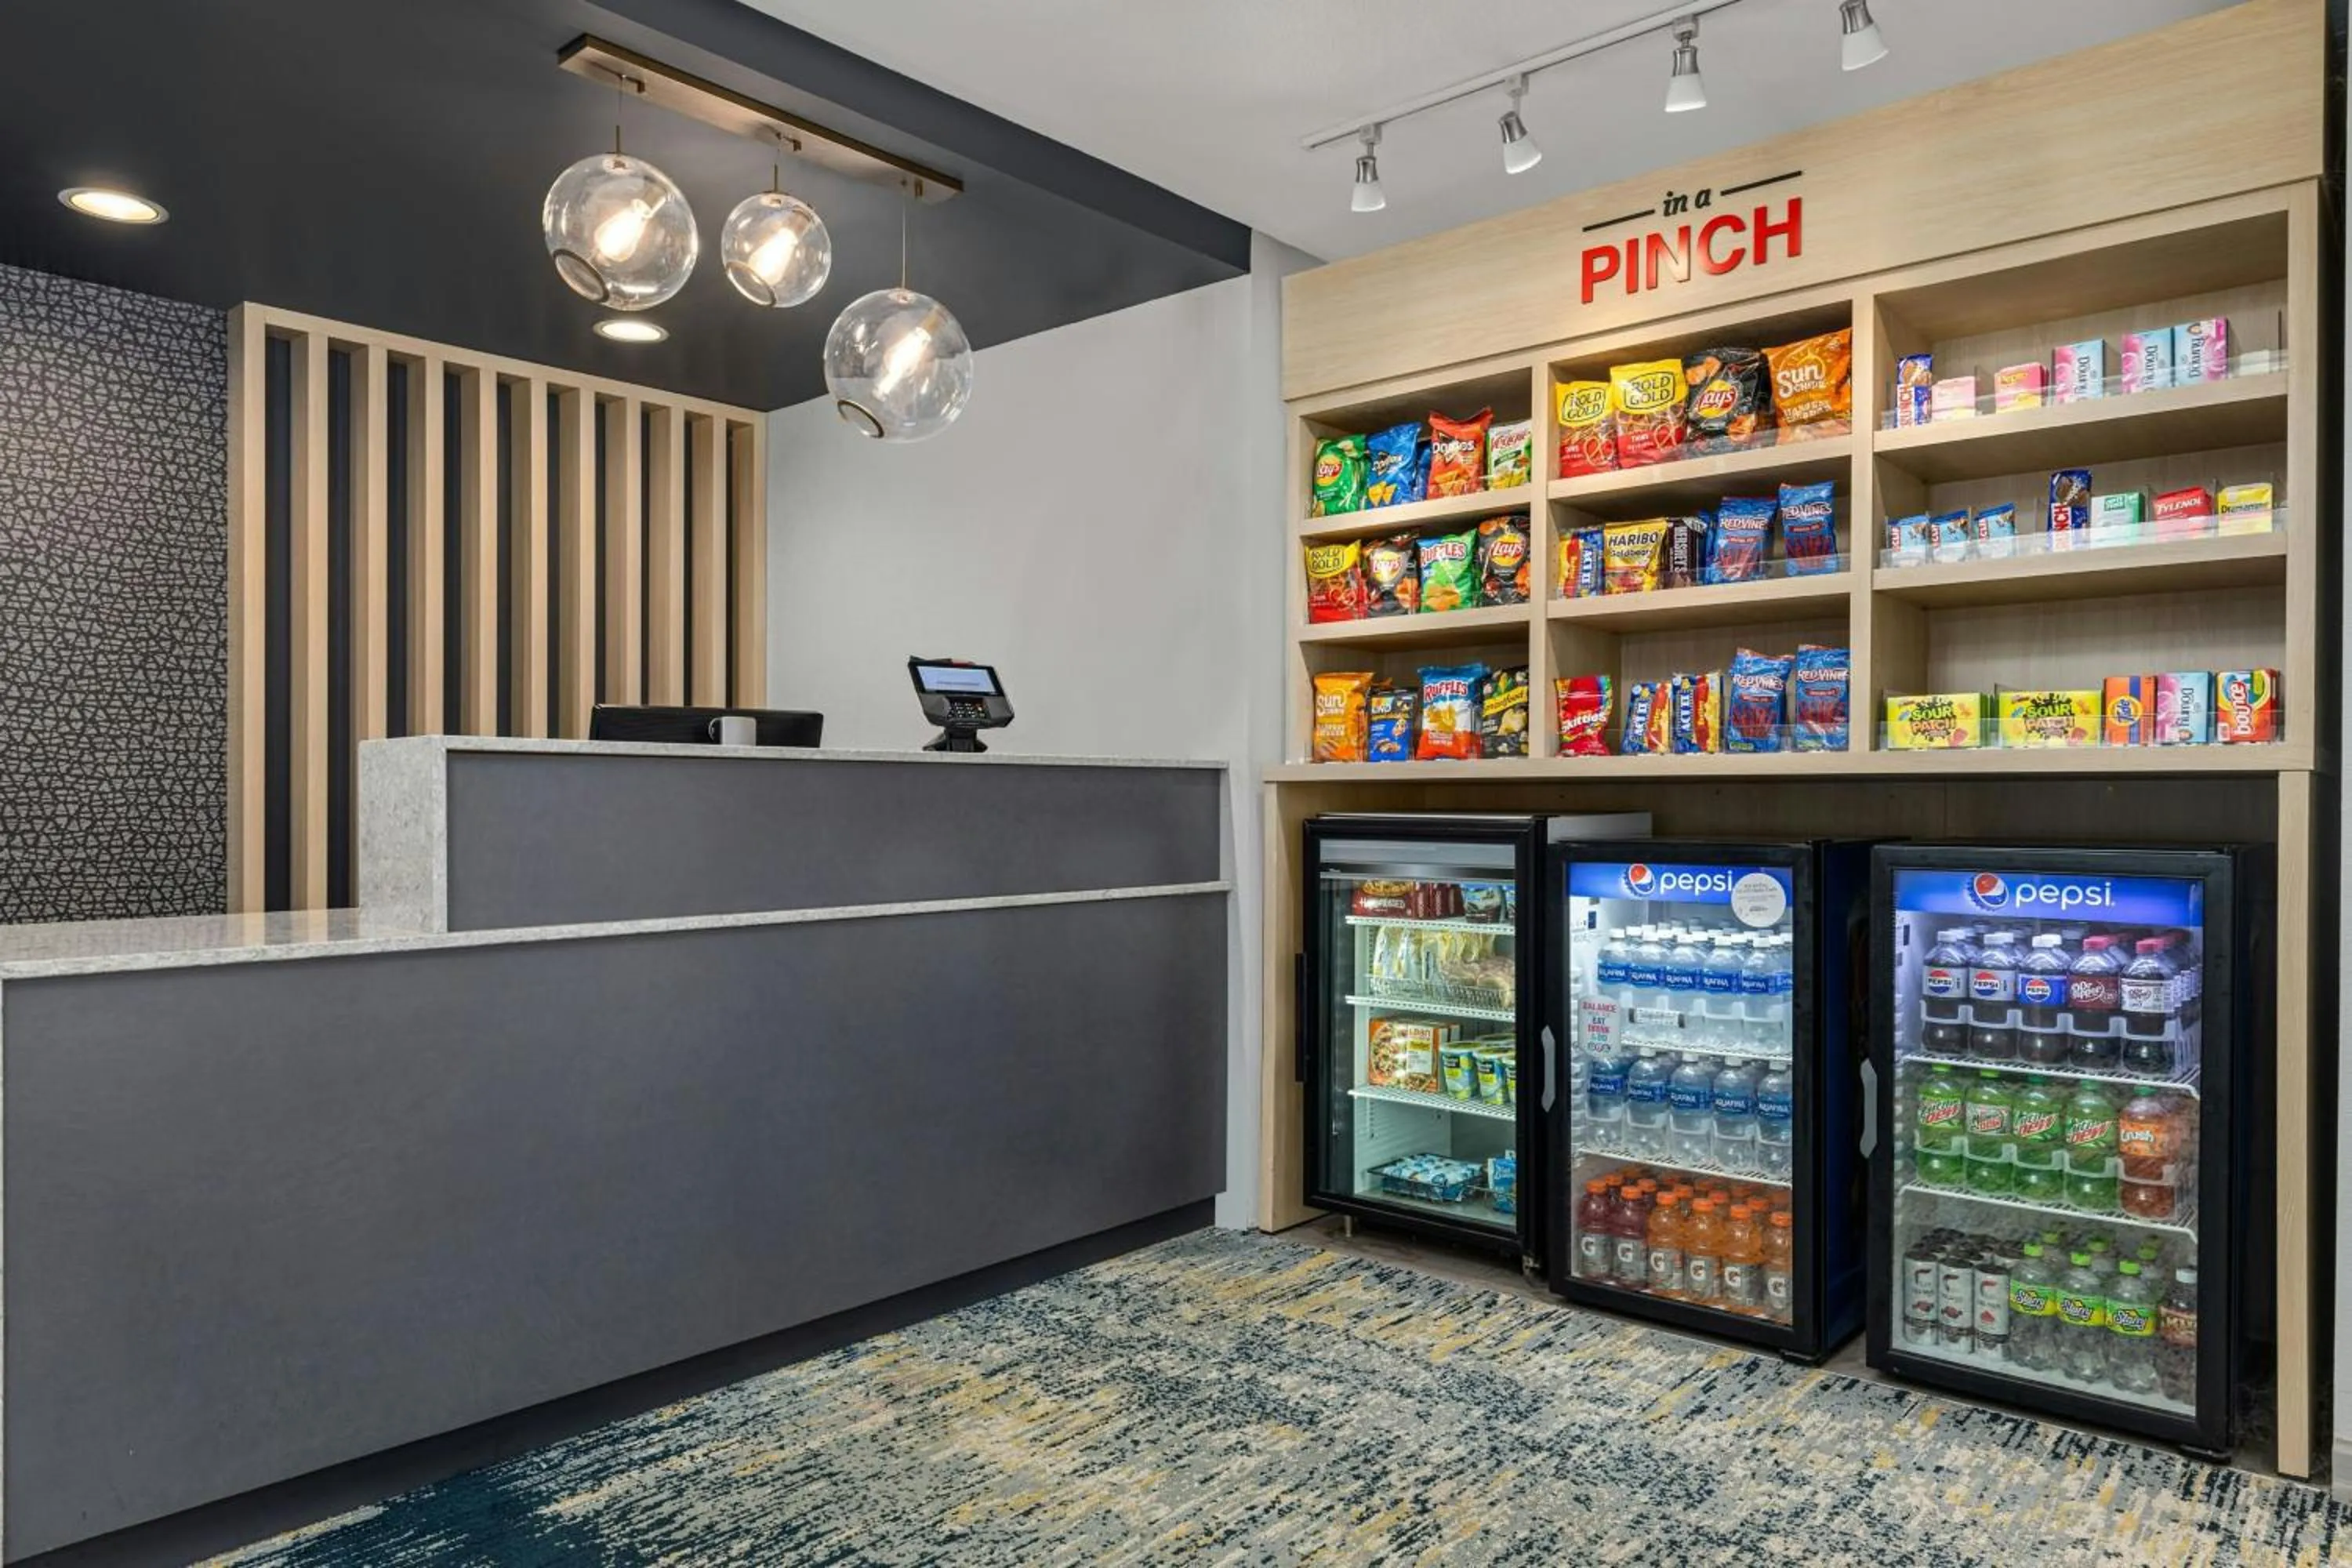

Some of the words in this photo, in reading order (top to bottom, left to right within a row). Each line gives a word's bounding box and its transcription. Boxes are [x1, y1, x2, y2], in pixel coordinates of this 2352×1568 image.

[1663, 191, 1688, 216] in
[1694, 188, 1712, 209] a
[1581, 197, 1802, 304] PINCH
[1631, 376, 1671, 393] ROLD
[1777, 364, 1824, 399] Sun
[1630, 389, 1670, 405] GOLD
[1568, 403, 1600, 419] GOLD
[2157, 498, 2202, 514] TYLENOL
[1609, 531, 1659, 547] HARIBO
[1424, 680, 1468, 701] RUFFLES
[1316, 694, 1348, 717] Sun
[1911, 705, 1953, 720] SOUR
[2025, 704, 2072, 717] SOUR
[2176, 687, 2194, 728] Downy
[2229, 681, 2253, 735] bounce
[1660, 870, 1733, 897] pepsi
[2016, 881, 2112, 911] pepsi
[1973, 980, 1998, 989] PEPSI
[1581, 1002, 1617, 1013] BALANCE
[1581, 1236, 1595, 1256] G
[1617, 1243, 1634, 1263] G
[1650, 1252, 1665, 1272] G
[1690, 1260, 1706, 1281] G
[1726, 1266, 1741, 1288] G
[1768, 1277, 1786, 1298] G
